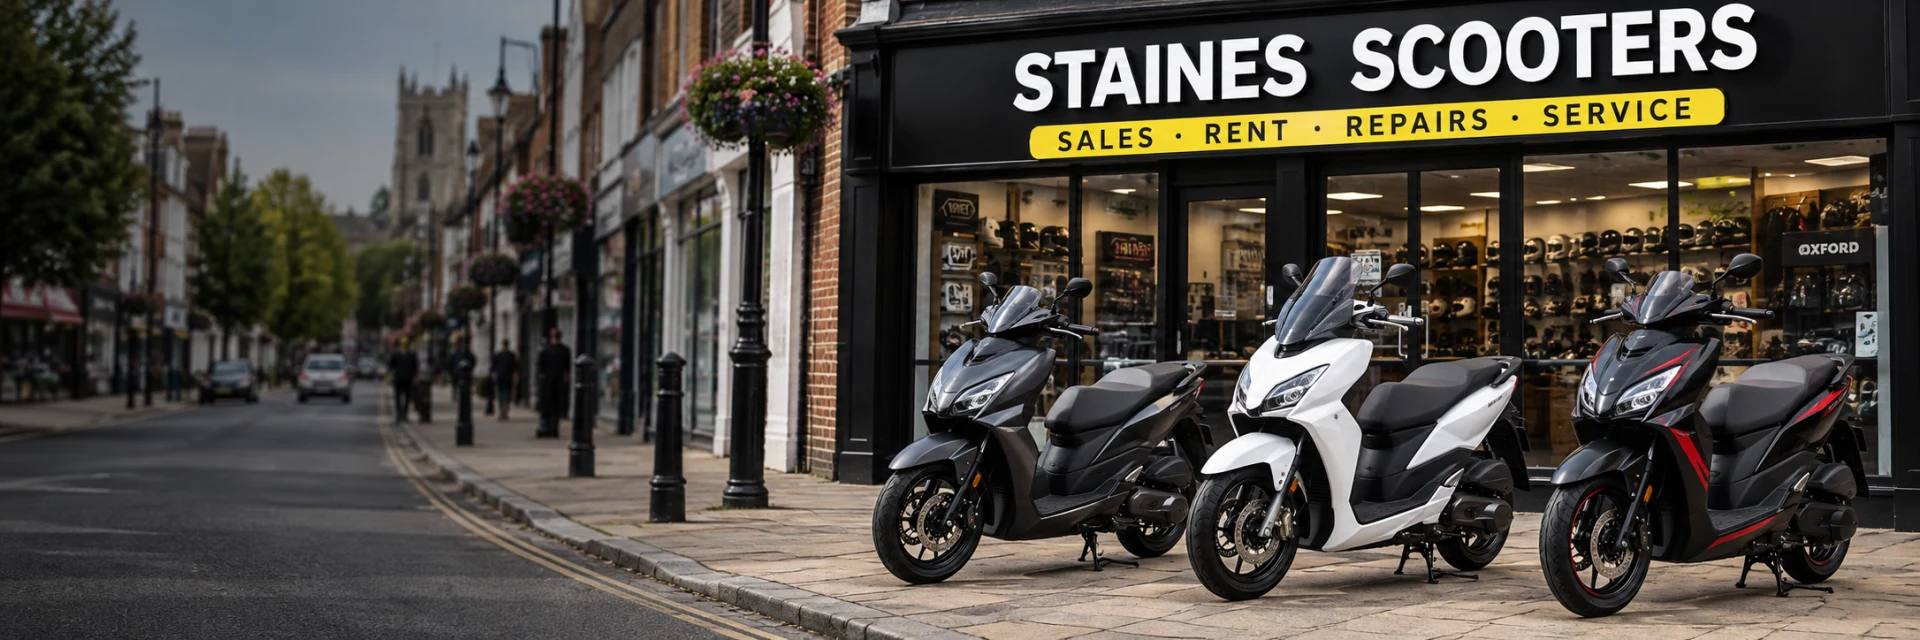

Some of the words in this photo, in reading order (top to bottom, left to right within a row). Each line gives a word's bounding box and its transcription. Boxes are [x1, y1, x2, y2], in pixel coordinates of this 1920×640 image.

[1012, 33, 1307, 112] STAINES
[1350, 3, 1758, 92] SCOOTERS
[1057, 126, 1154, 152] SALES
[1205, 120, 1289, 145] RENT
[1346, 108, 1489, 137] REPAIRS
[1543, 97, 1691, 127] SERVICE
[1798, 241, 1860, 256] OXFORD
